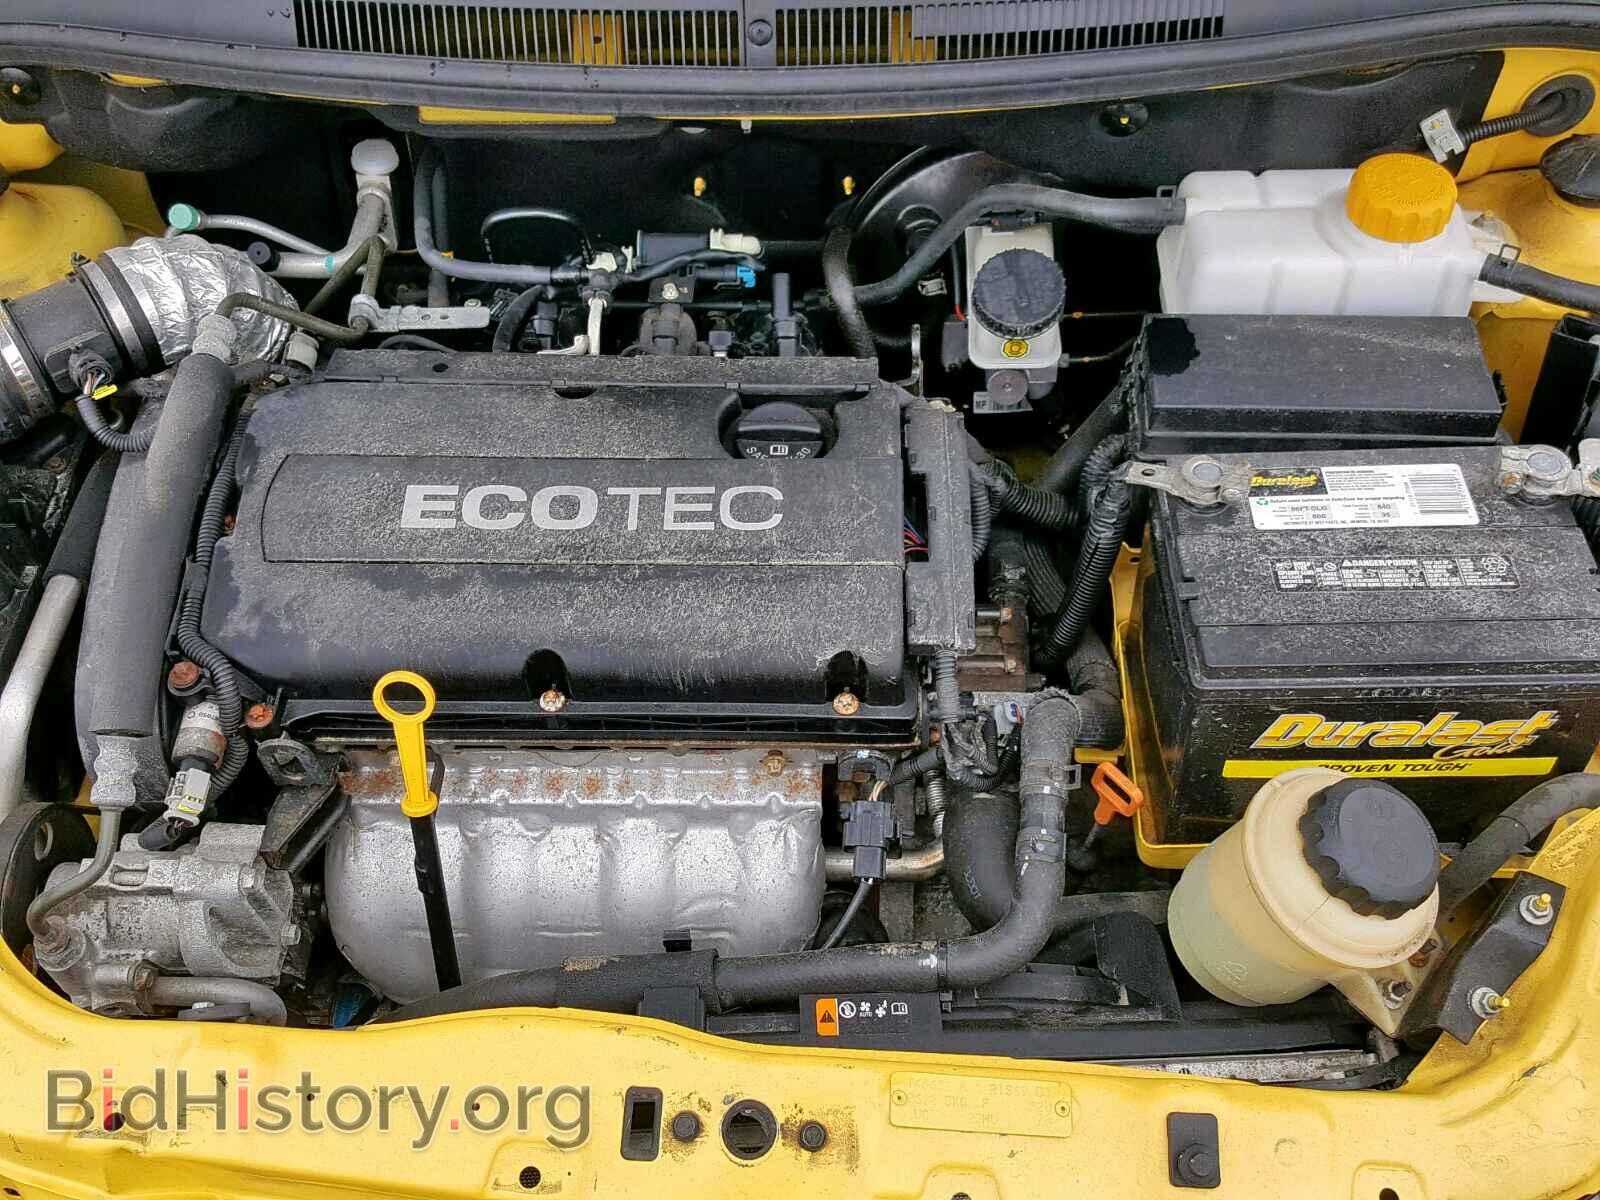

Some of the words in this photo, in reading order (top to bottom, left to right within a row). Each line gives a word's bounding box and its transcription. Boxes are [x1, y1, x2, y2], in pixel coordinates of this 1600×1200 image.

[400, 484, 785, 531] ECOTEC
[1250, 710, 1559, 748] Duralast
[1318, 763, 1397, 773] ROVEN
[1400, 762, 1468, 772] TOUGH
